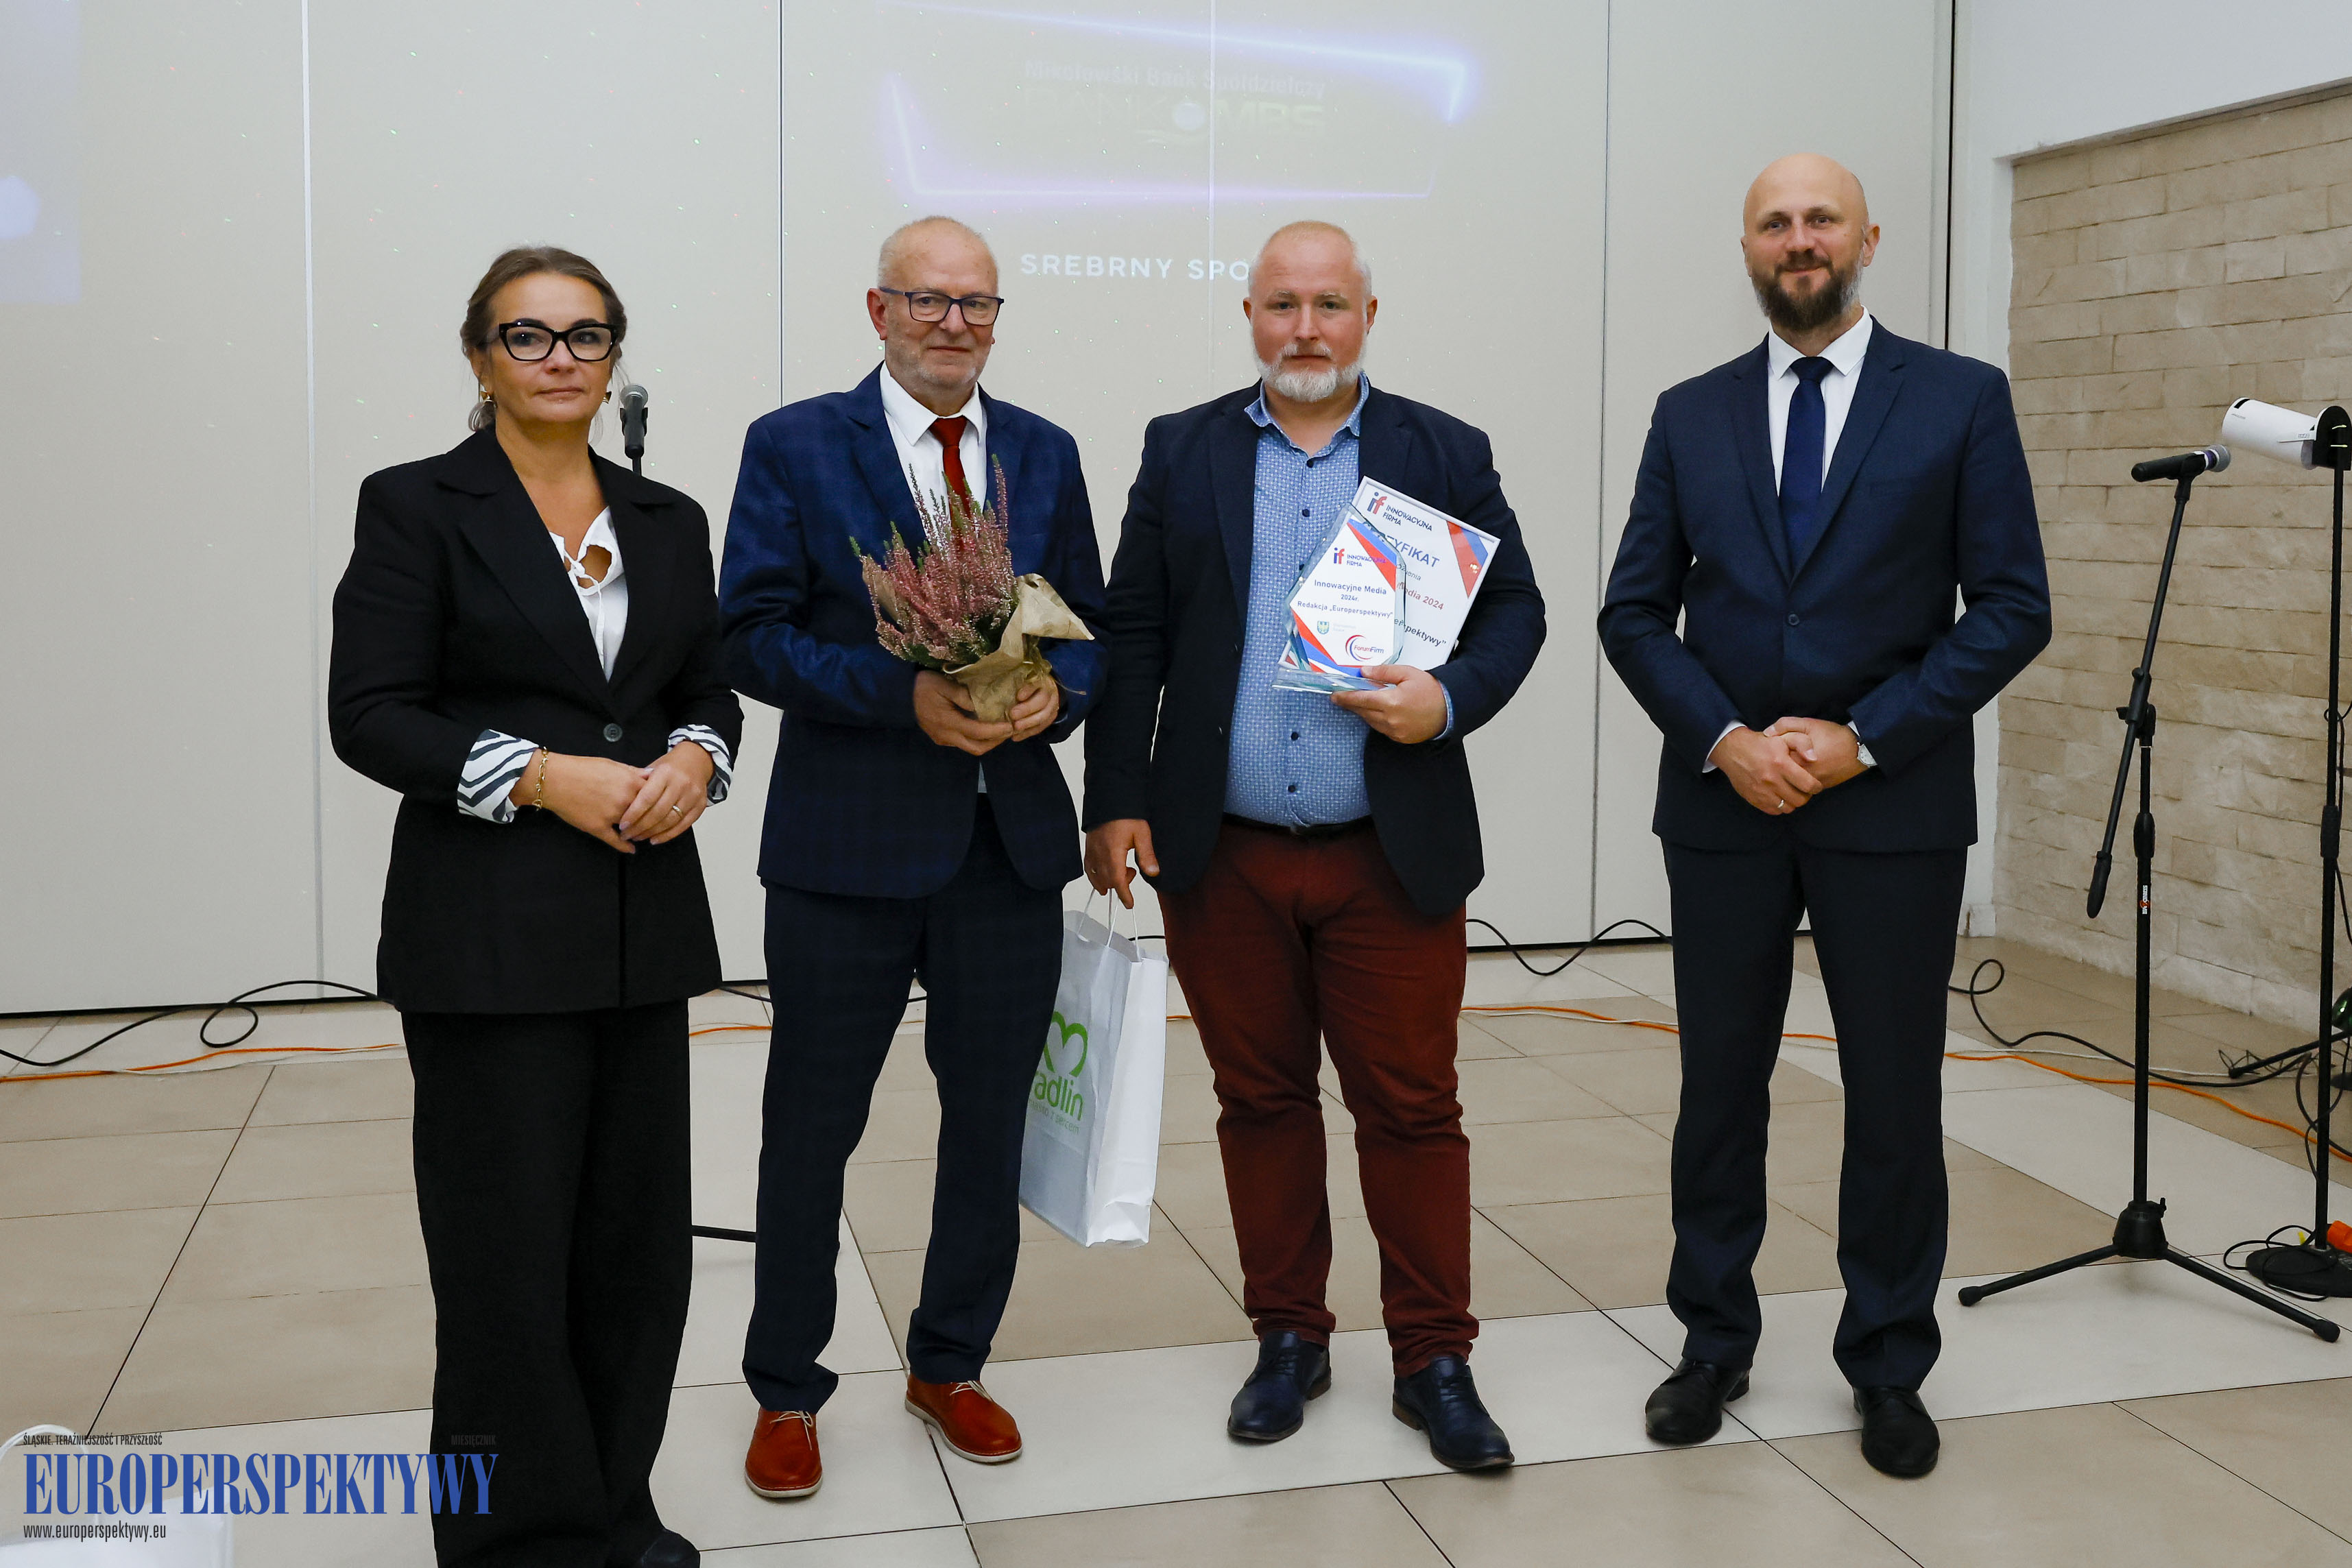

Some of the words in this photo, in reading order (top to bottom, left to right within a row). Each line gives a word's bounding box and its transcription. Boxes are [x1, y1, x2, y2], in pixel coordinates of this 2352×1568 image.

[1147, 67, 1196, 88] Bank
[1020, 254, 1173, 278] SREBRNY
[1188, 258, 1249, 281] SPO
[1382, 512, 1402, 526] FIRMA
[1386, 505, 1432, 531] INNOWACYJNA
[1315, 579, 1362, 592] Innowacyjne
[1364, 585, 1387, 595] Media
[1341, 594, 1359, 602] 2024r.
[1423, 596, 1445, 611] 2024
[1297, 601, 1328, 611] Redakcja
[1354, 645, 1384, 653] ForumFirm
